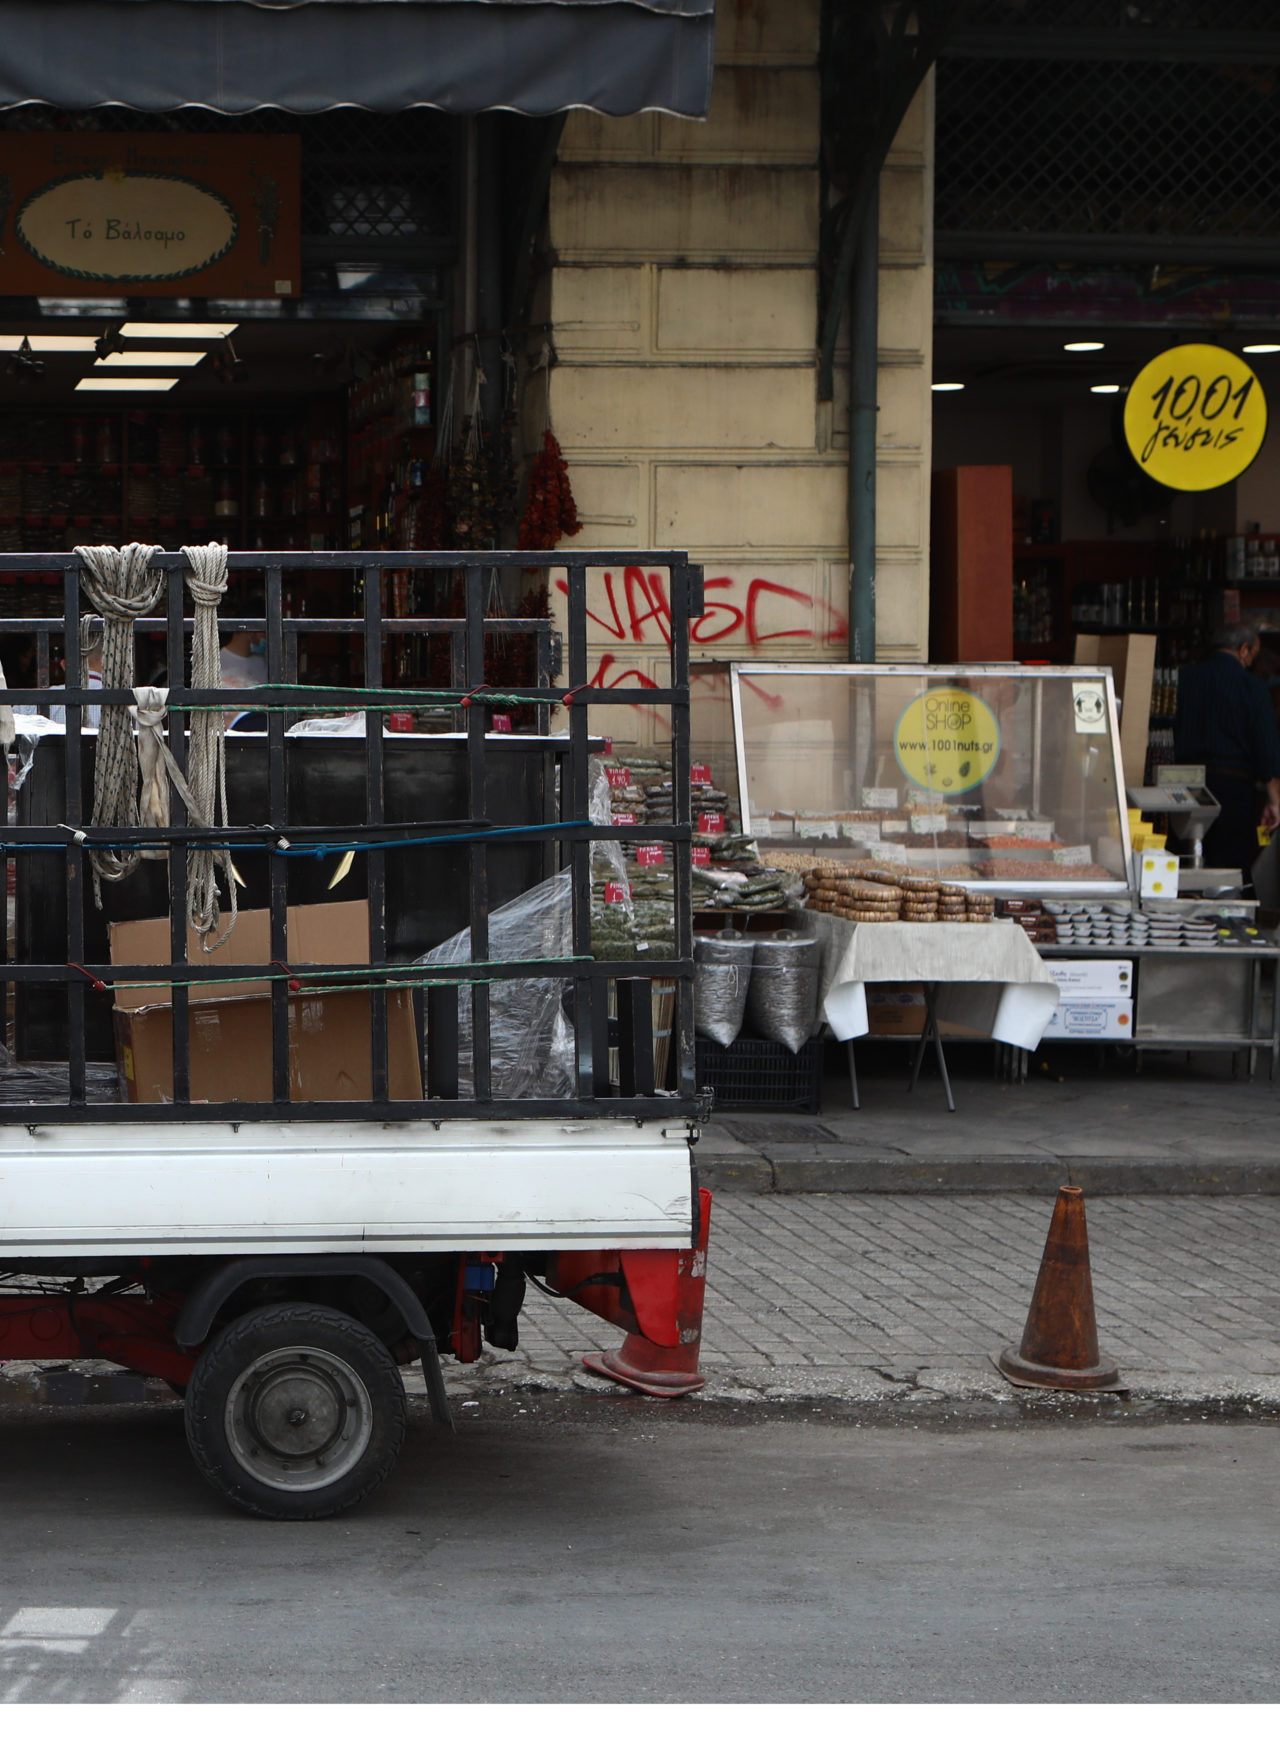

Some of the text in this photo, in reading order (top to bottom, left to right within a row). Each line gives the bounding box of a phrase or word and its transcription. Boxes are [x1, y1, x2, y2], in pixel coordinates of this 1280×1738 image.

[1152, 374, 1254, 421] 1001
[925, 697, 971, 713] Online
[926, 713, 972, 731] SHOP
